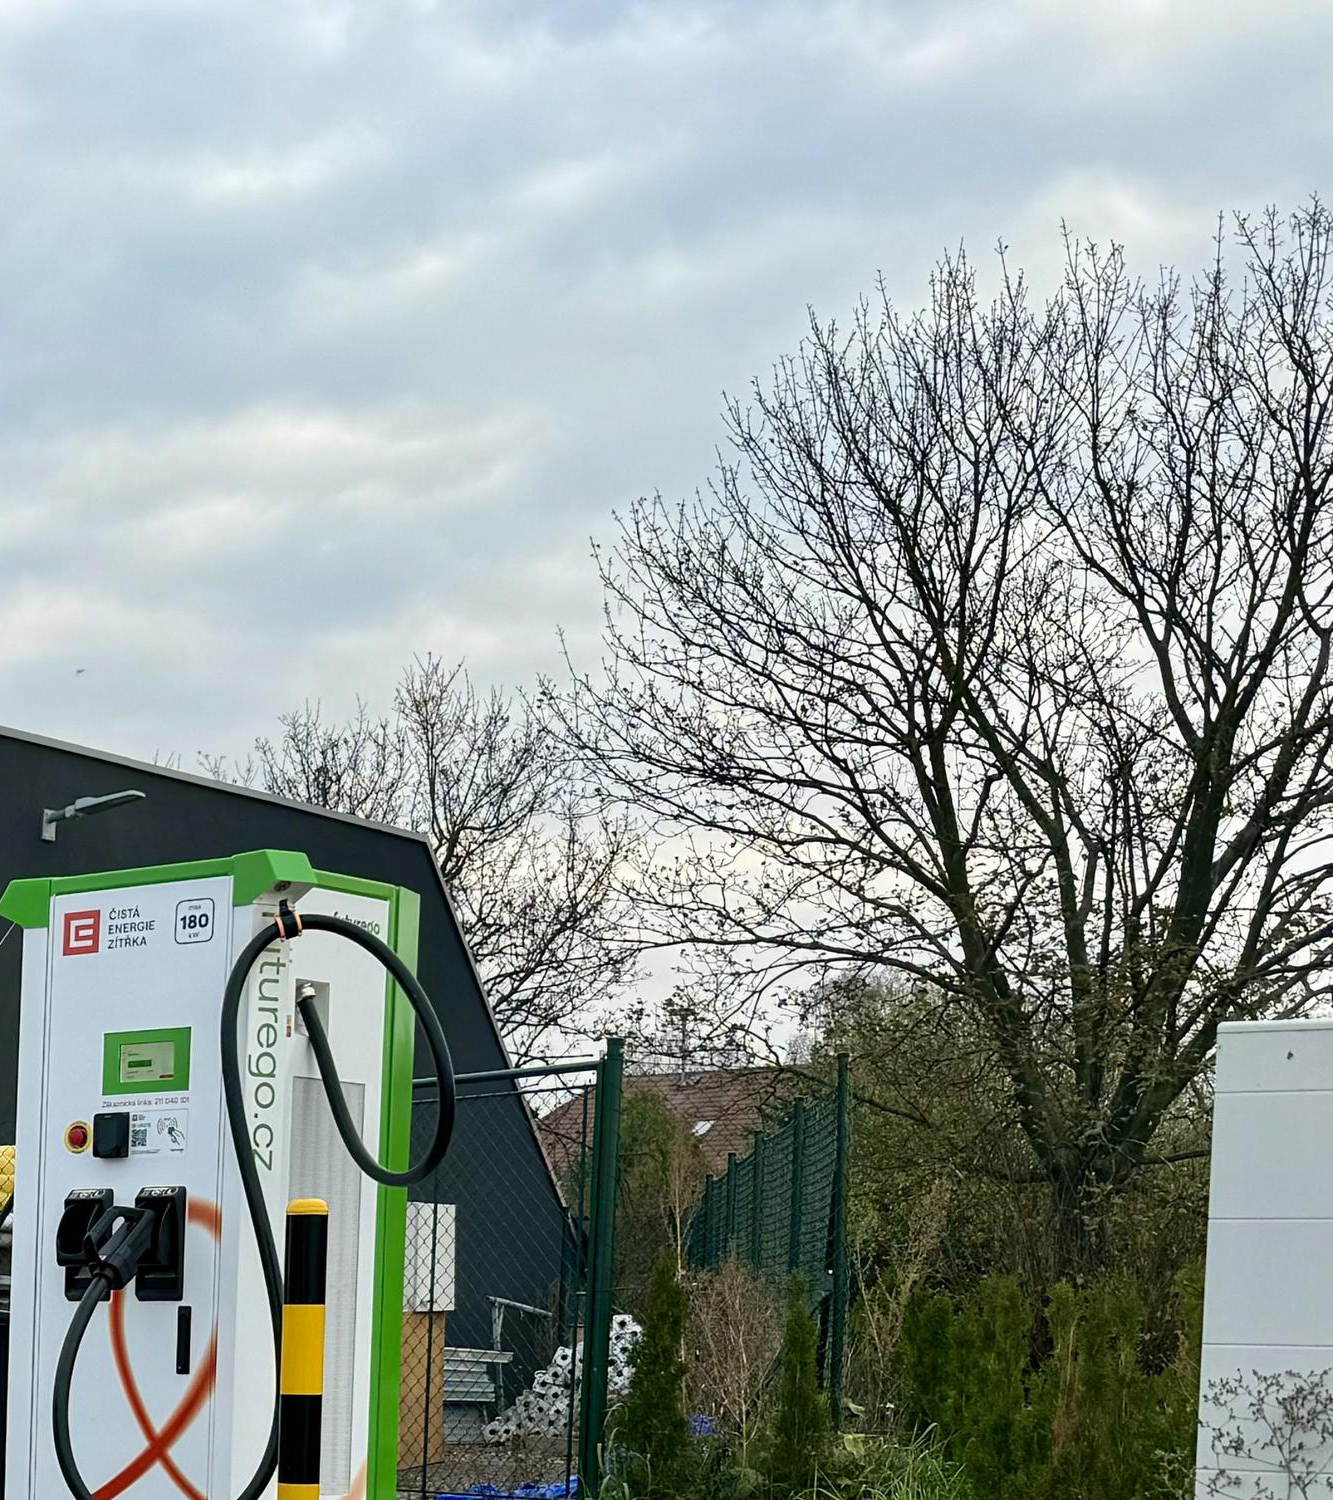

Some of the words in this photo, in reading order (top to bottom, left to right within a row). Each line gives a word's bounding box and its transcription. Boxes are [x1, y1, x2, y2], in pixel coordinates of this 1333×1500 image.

[109, 905, 140, 920] ČISTÁ
[108, 920, 155, 935] ENERGIE
[180, 914, 209, 930] 180
[108, 936, 147, 949] ZÍTŘKA
